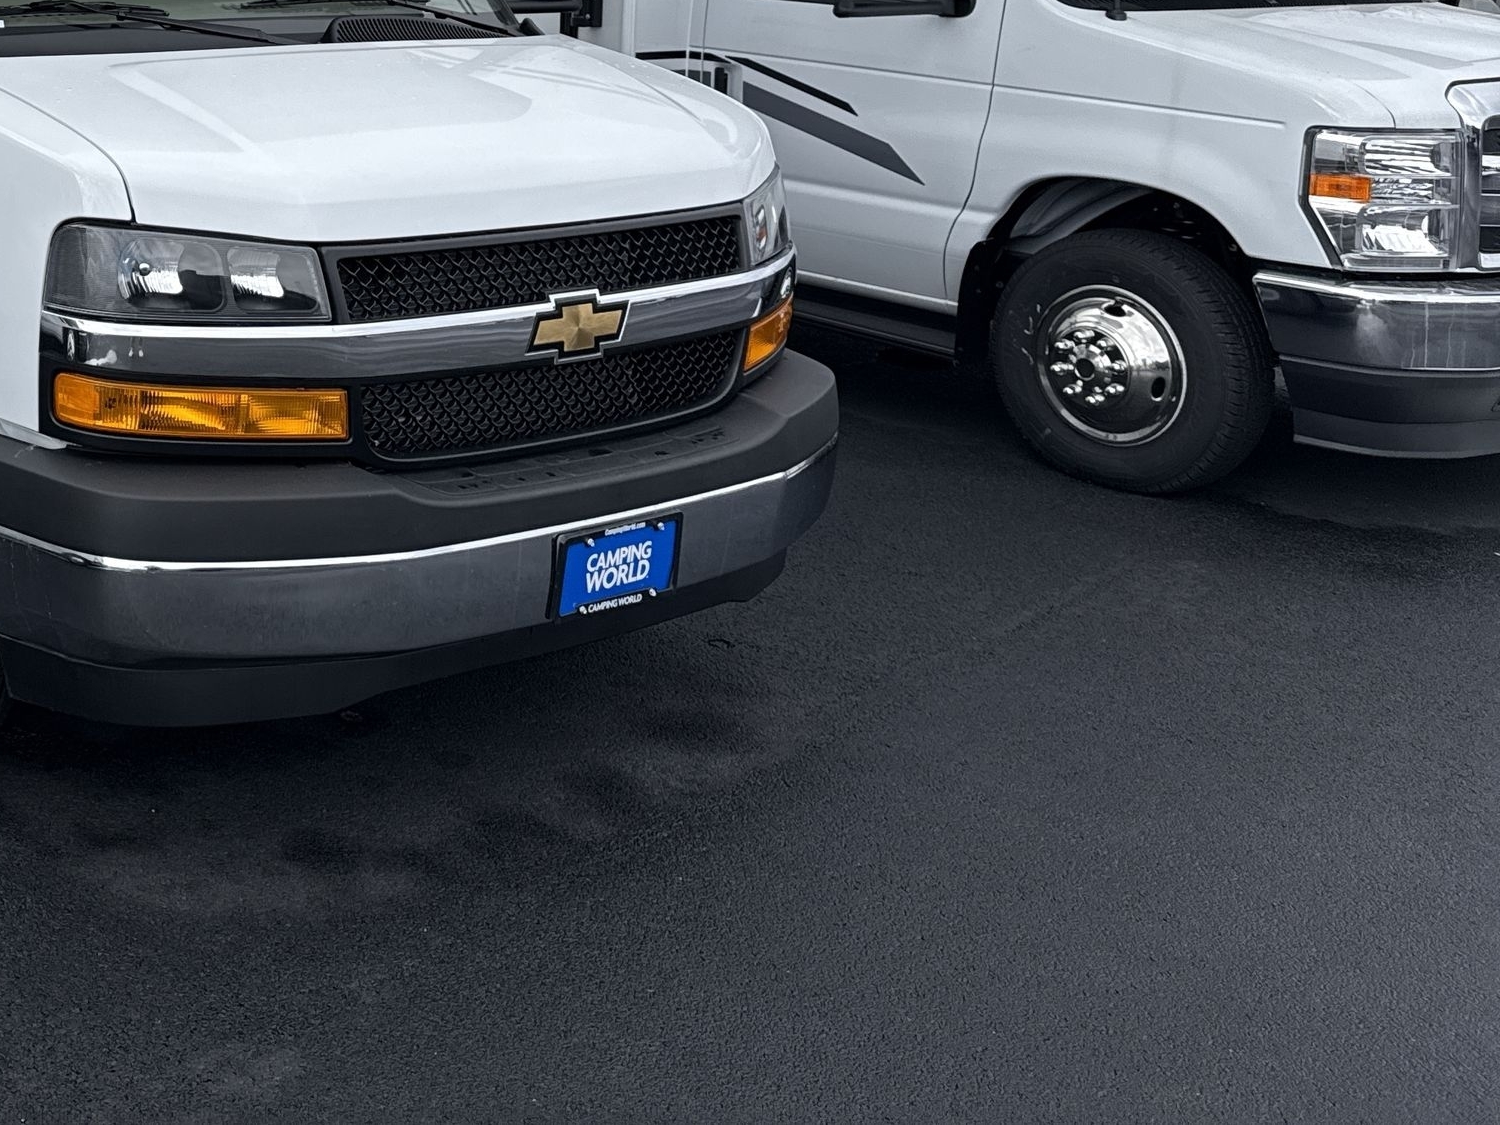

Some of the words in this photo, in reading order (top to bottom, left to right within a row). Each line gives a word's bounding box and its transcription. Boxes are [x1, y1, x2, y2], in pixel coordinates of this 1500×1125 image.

[586, 540, 652, 572] CAMPING
[586, 559, 649, 593] WORLD
[587, 597, 618, 613] CAMPING
[618, 593, 643, 607] WORLD
